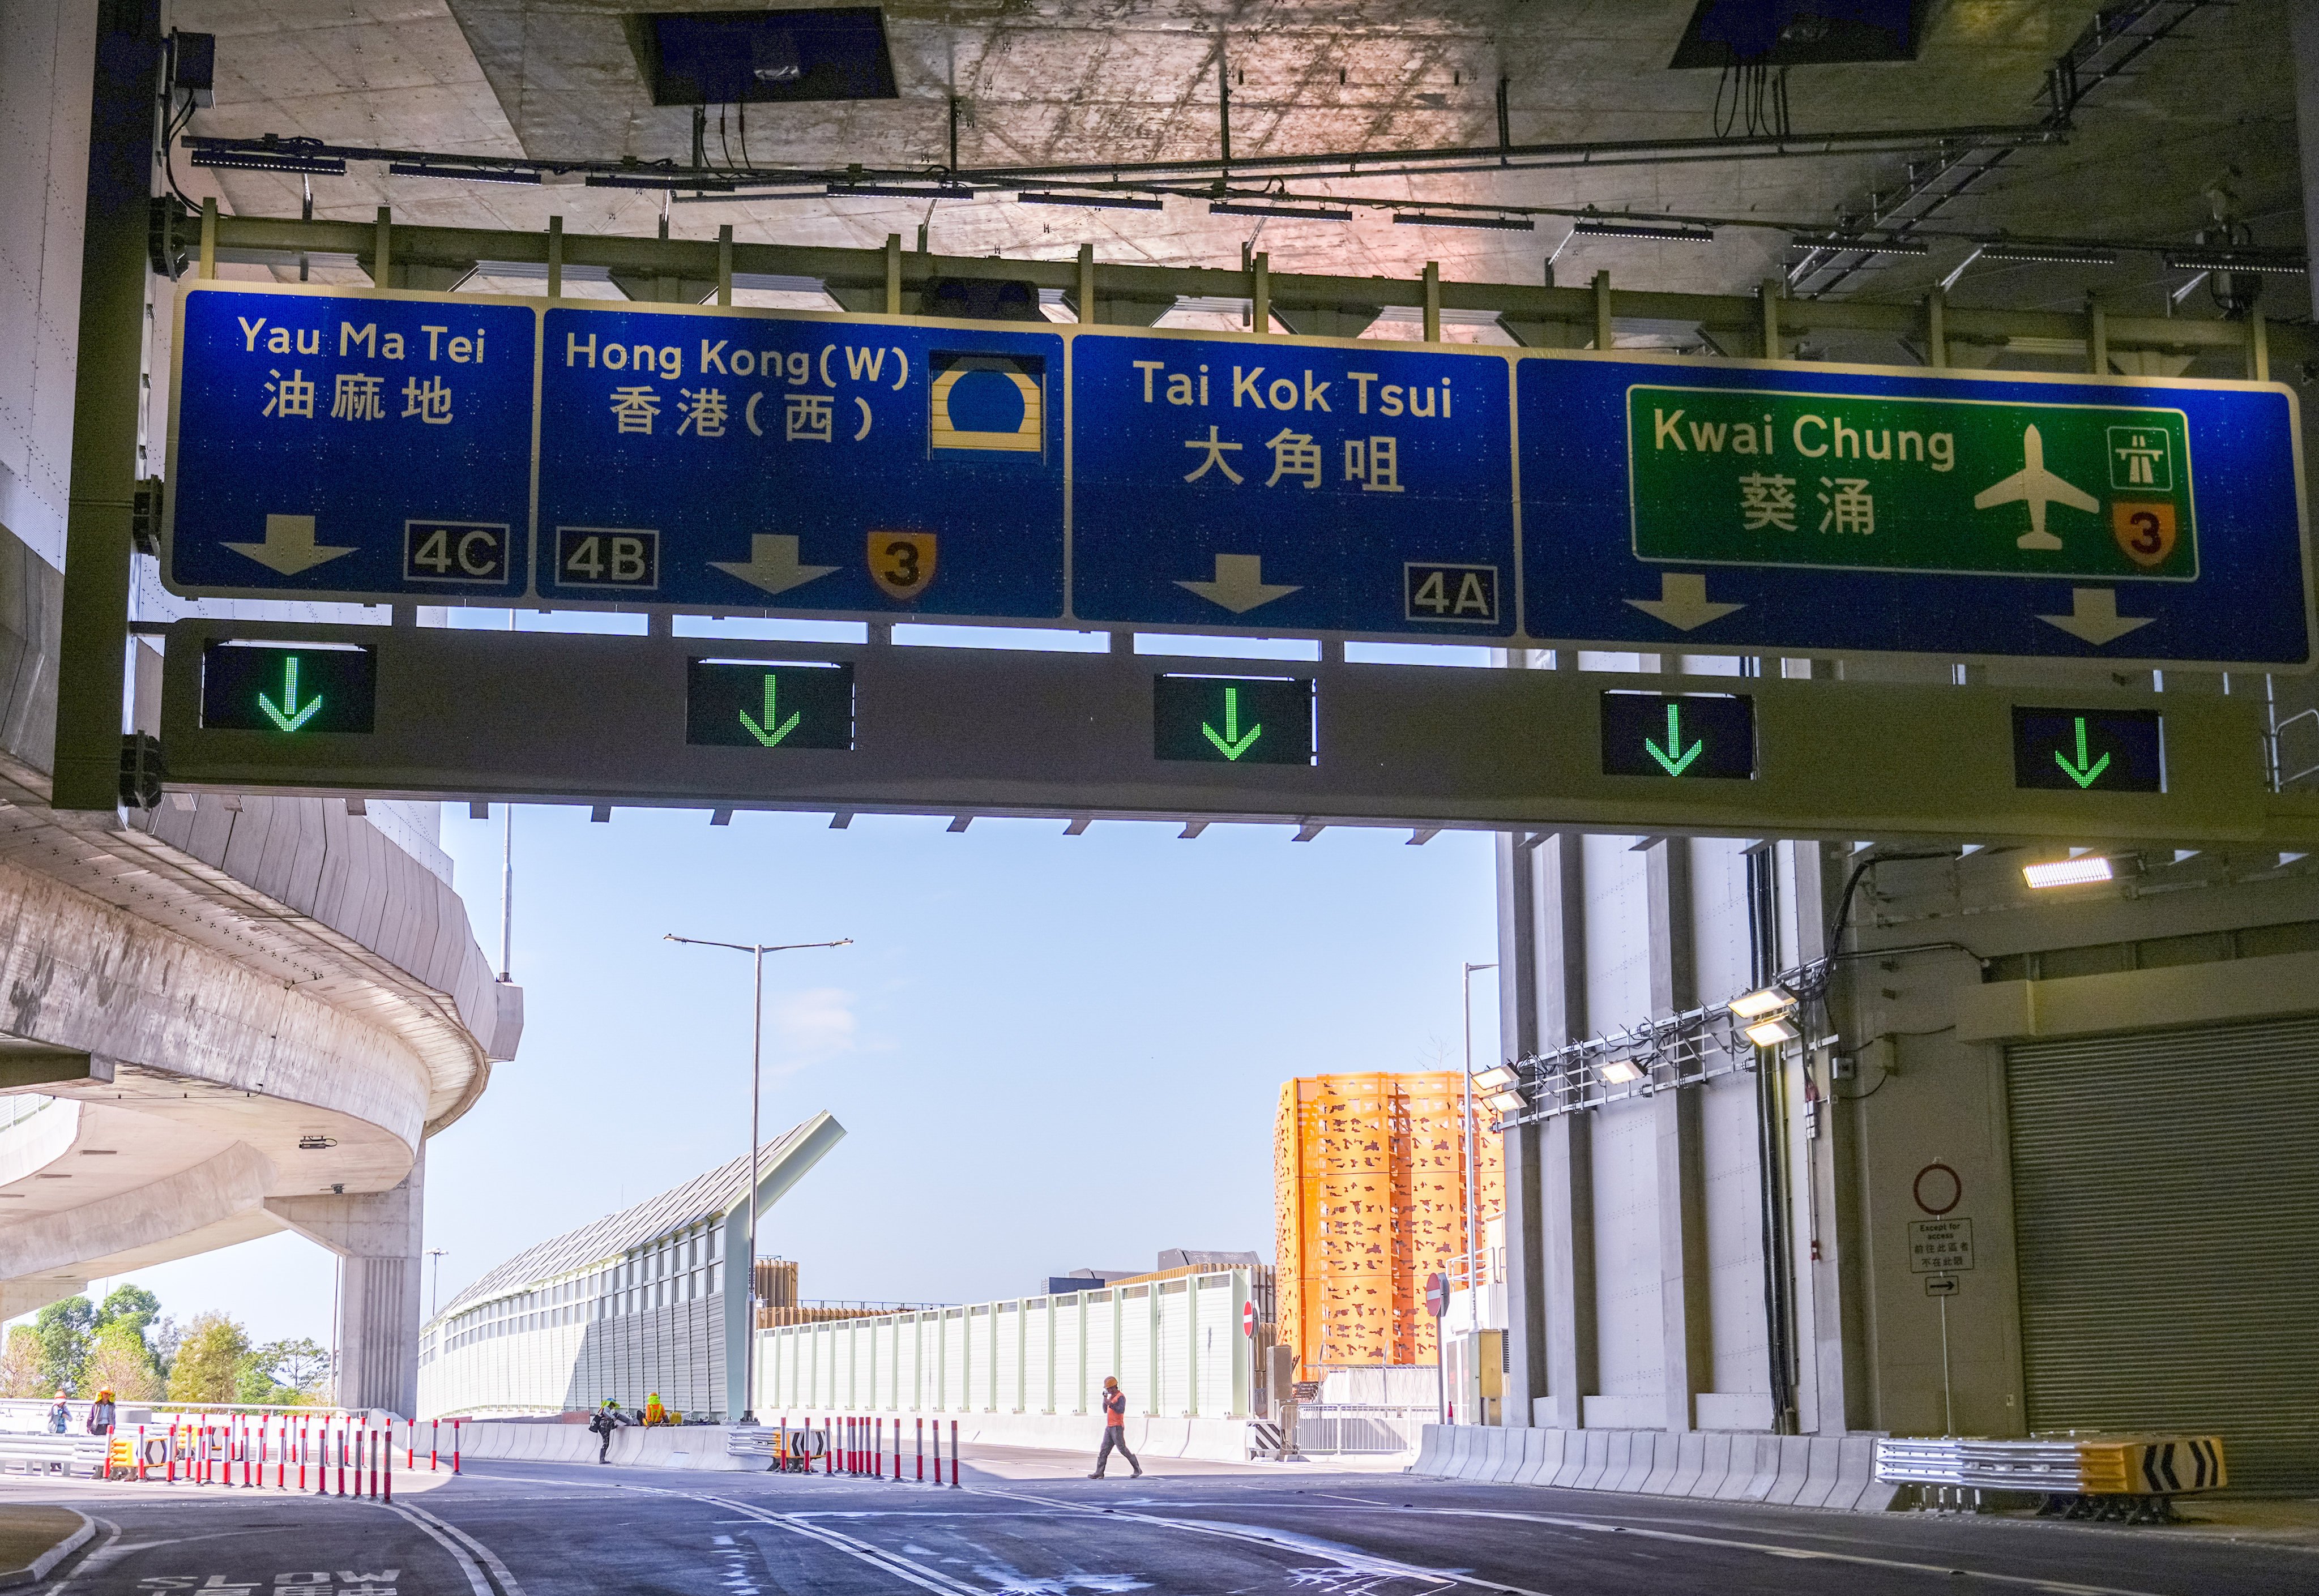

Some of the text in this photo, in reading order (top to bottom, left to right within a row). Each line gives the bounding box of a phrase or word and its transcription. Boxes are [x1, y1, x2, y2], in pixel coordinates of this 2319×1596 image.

[237, 317, 485, 363] Yau Ma Tei
[567, 333, 908, 391] Hong Kong(W)
[262, 369, 453, 425] 油麻地
[610, 386, 872, 443] 香港(西)
[1133, 361, 1451, 418] Tai Kok Tsui
[1184, 425, 1404, 493] 大角咀
[1655, 409, 1954, 472] Kwai Chung
[1739, 472, 1874, 535] 葵涌
[414, 529, 497, 575] 4C
[567, 536, 646, 581] 4B
[2130, 512, 2161, 554] 3
[885, 542, 920, 587] 3
[1413, 571, 1489, 615] 4A
[136, 1569, 400, 1589] SLOW
